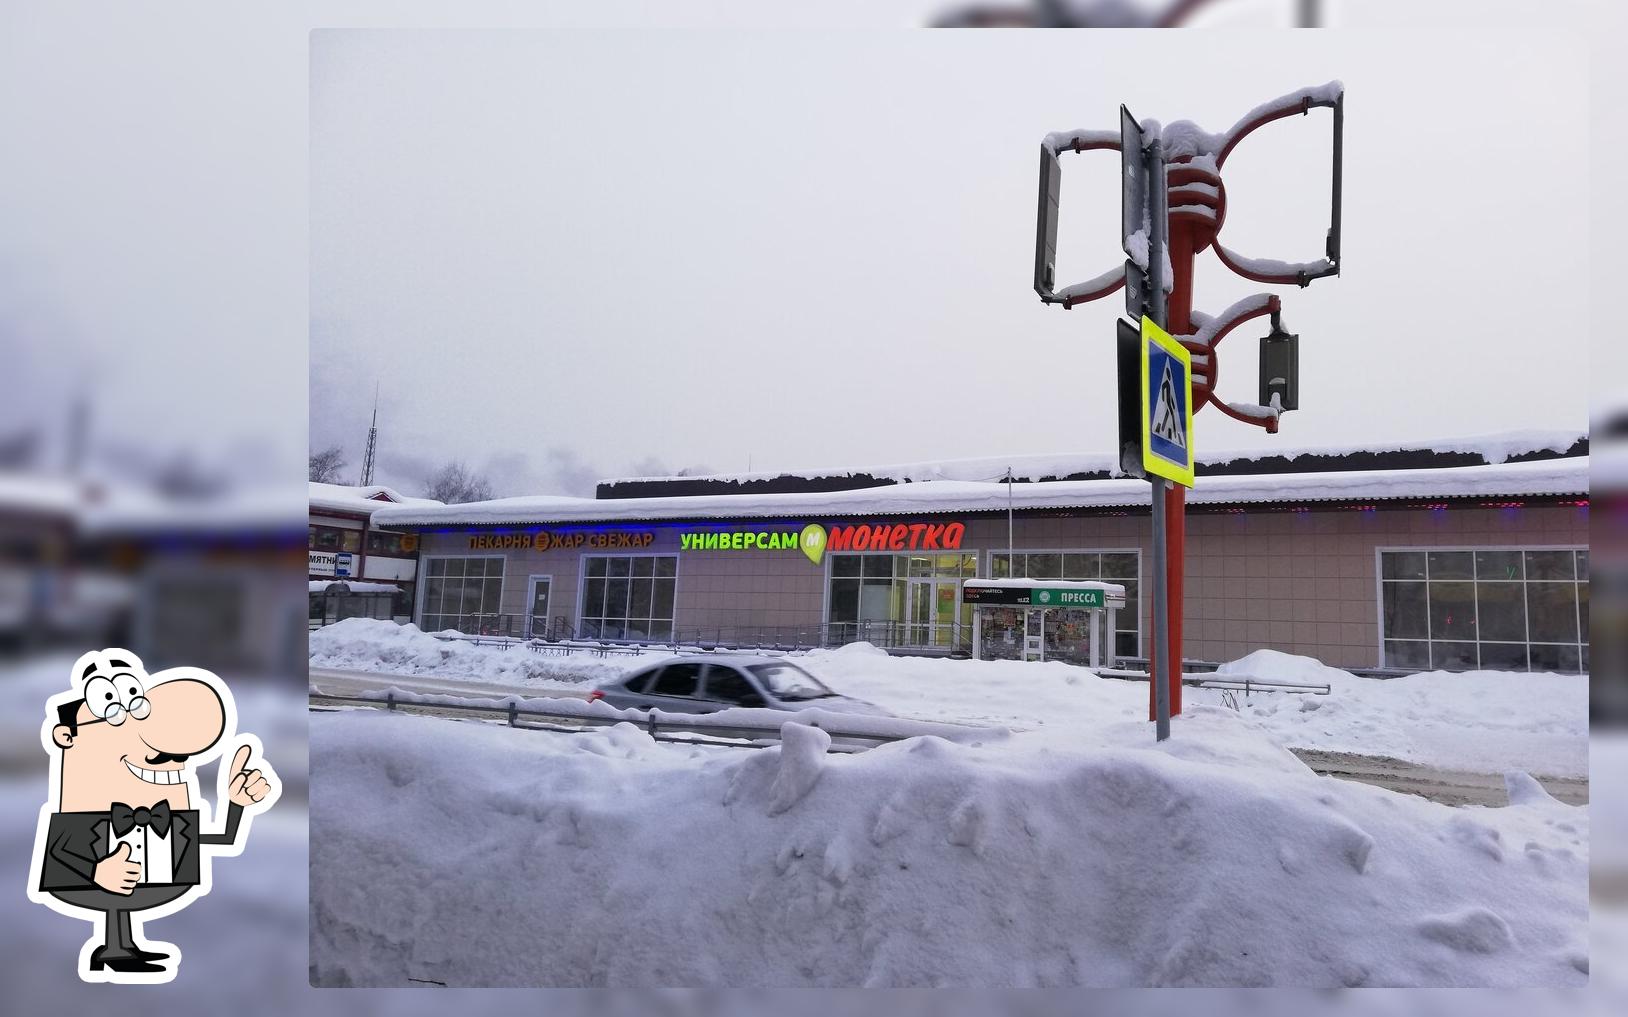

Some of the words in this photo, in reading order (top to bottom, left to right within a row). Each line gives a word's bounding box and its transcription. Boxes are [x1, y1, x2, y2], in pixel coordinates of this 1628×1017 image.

[469, 533, 531, 550] ПЕКАРНЯ
[549, 533, 585, 549] ЖАР
[588, 532, 655, 549] СВЕЖАР
[680, 532, 798, 551] УНИВЕРСАМ
[1061, 592, 1097, 603] ПРЕССА
